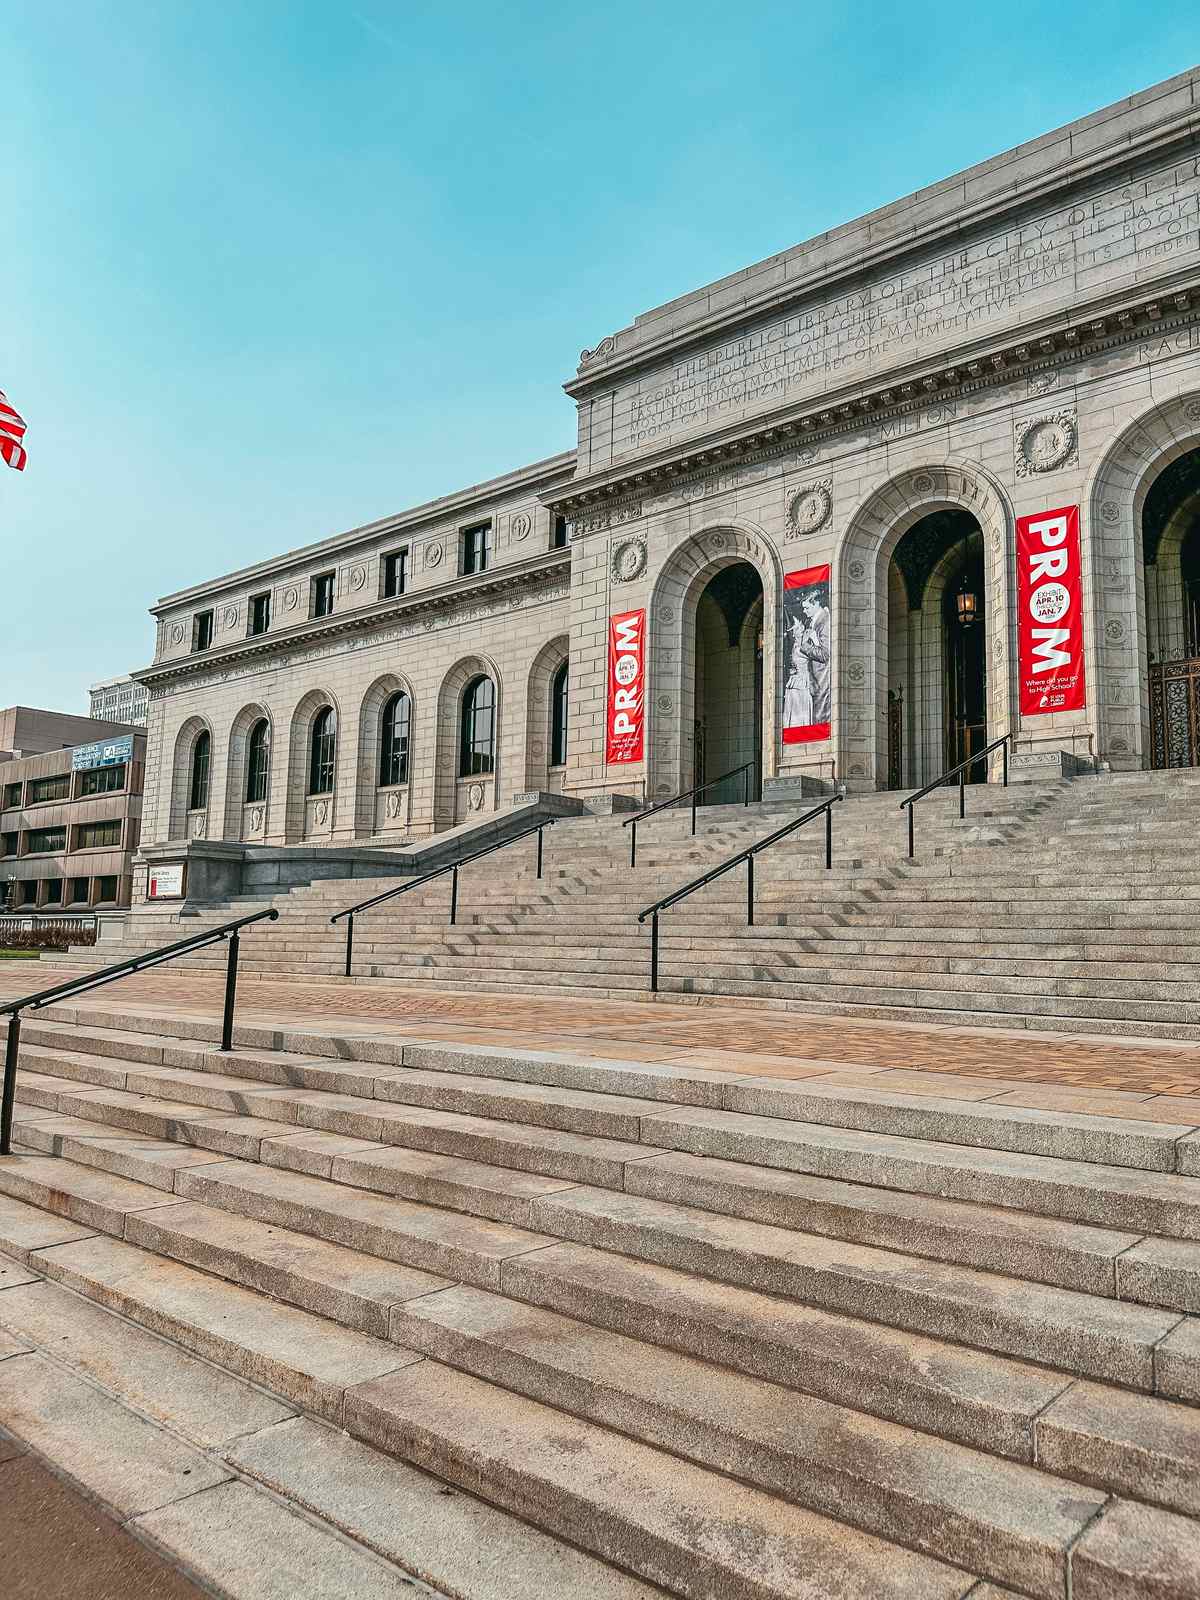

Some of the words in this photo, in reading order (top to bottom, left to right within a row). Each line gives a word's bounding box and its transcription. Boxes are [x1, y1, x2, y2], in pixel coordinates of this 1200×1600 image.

[631, 378, 697, 411] RECORDED
[705, 346, 768, 382] THOUGHT
[801, 326, 831, 345] OUR
[841, 305, 882, 330] CHIEF
[895, 265, 983, 310] HERITAGE
[998, 240, 1053, 270] FROM
[1067, 218, 1105, 242] THE
[1124, 190, 1180, 223] PAST
[631, 393, 681, 422] LASTING
[693, 367, 748, 400] LEGACY
[760, 356, 779, 371] WE
[793, 339, 825, 360] CAN
[836, 315, 888, 346] LEAVE
[901, 303, 925, 320] TO
[940, 281, 973, 305] THE
[988, 248, 1065, 290] FUTURE
[1123, 202, 1190, 240] BOOK
[674, 355, 706, 380] THE
[715, 328, 778, 365] PUBLIC
[787, 290, 869, 337] LIBRARY
[881, 276, 910, 299] OF
[924, 250, 969, 281] THE
[986, 220, 1048, 258] CITY
[1069, 199, 1102, 226] OF
[1121, 179, 1153, 206] ST
[630, 423, 671, 444] BOOKS
[901, 294, 1018, 344] CUMULATIVE
[631, 411, 664, 431] MOST
[671, 386, 740, 419] ENDURING
[750, 343, 842, 389] MONUMENT
[855, 331, 876, 349] OF
[881, 400, 957, 440] MILTON
[1029, 515, 1071, 674] PROM
[1036, 596, 1054, 605] APR.
[1037, 588, 1062, 598] EXHIBIT
[1038, 608, 1056, 617] JAN.
[1057, 606, 1063, 614] 7
[614, 616, 640, 735] PROM
[1026, 679, 1046, 687] Where
[1057, 676, 1069, 684] you
